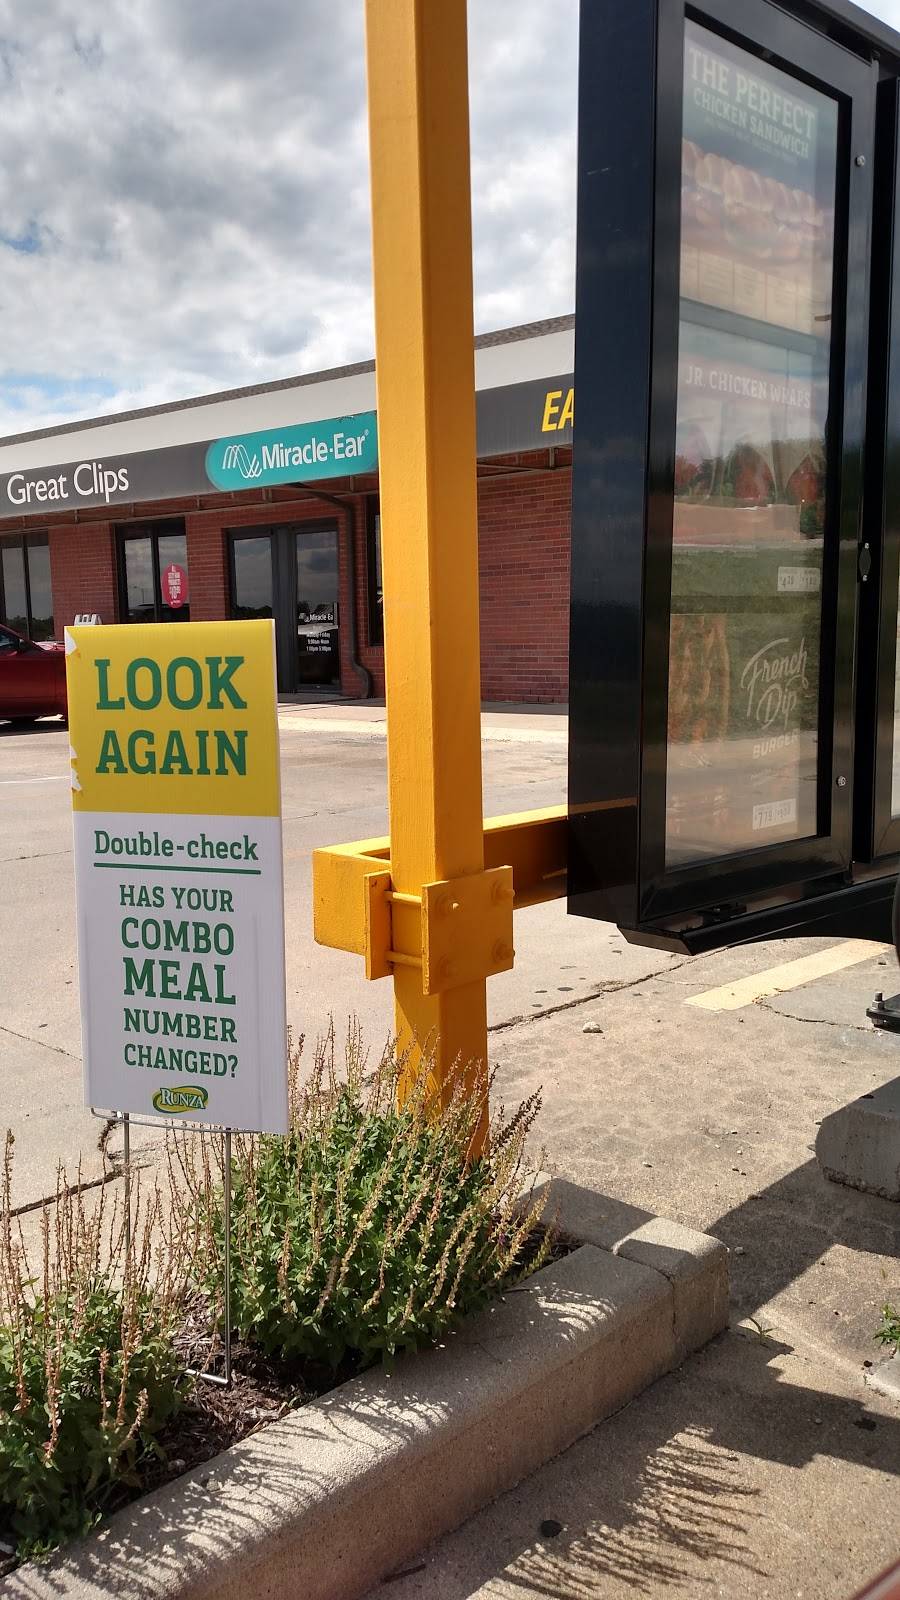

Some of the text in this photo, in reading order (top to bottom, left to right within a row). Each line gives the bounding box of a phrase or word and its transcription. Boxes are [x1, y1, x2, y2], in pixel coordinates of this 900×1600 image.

[689, 48, 816, 139] THE PERFECT
[694, 87, 748, 128] CHICKEN
[750, 115, 809, 158] SANDWICH
[709, 371, 767, 399] CHICKEN
[7, 462, 129, 505] Great Clips
[94, 656, 248, 710] LOOK
[741, 637, 809, 718] French
[757, 675, 800, 731] Dip
[95, 730, 248, 776] AGAIN
[752, 728, 800, 760] BURGER
[94, 830, 258, 861] Double-check
[119, 884, 234, 912] HAS YOUR
[121, 917, 235, 956] COMBO
[122, 957, 236, 1005] MEAL
[123, 1007, 237, 1043] NUMBER
[124, 1043, 238, 1078] CHANGED?
[159, 1087, 206, 1110] RUNZA
